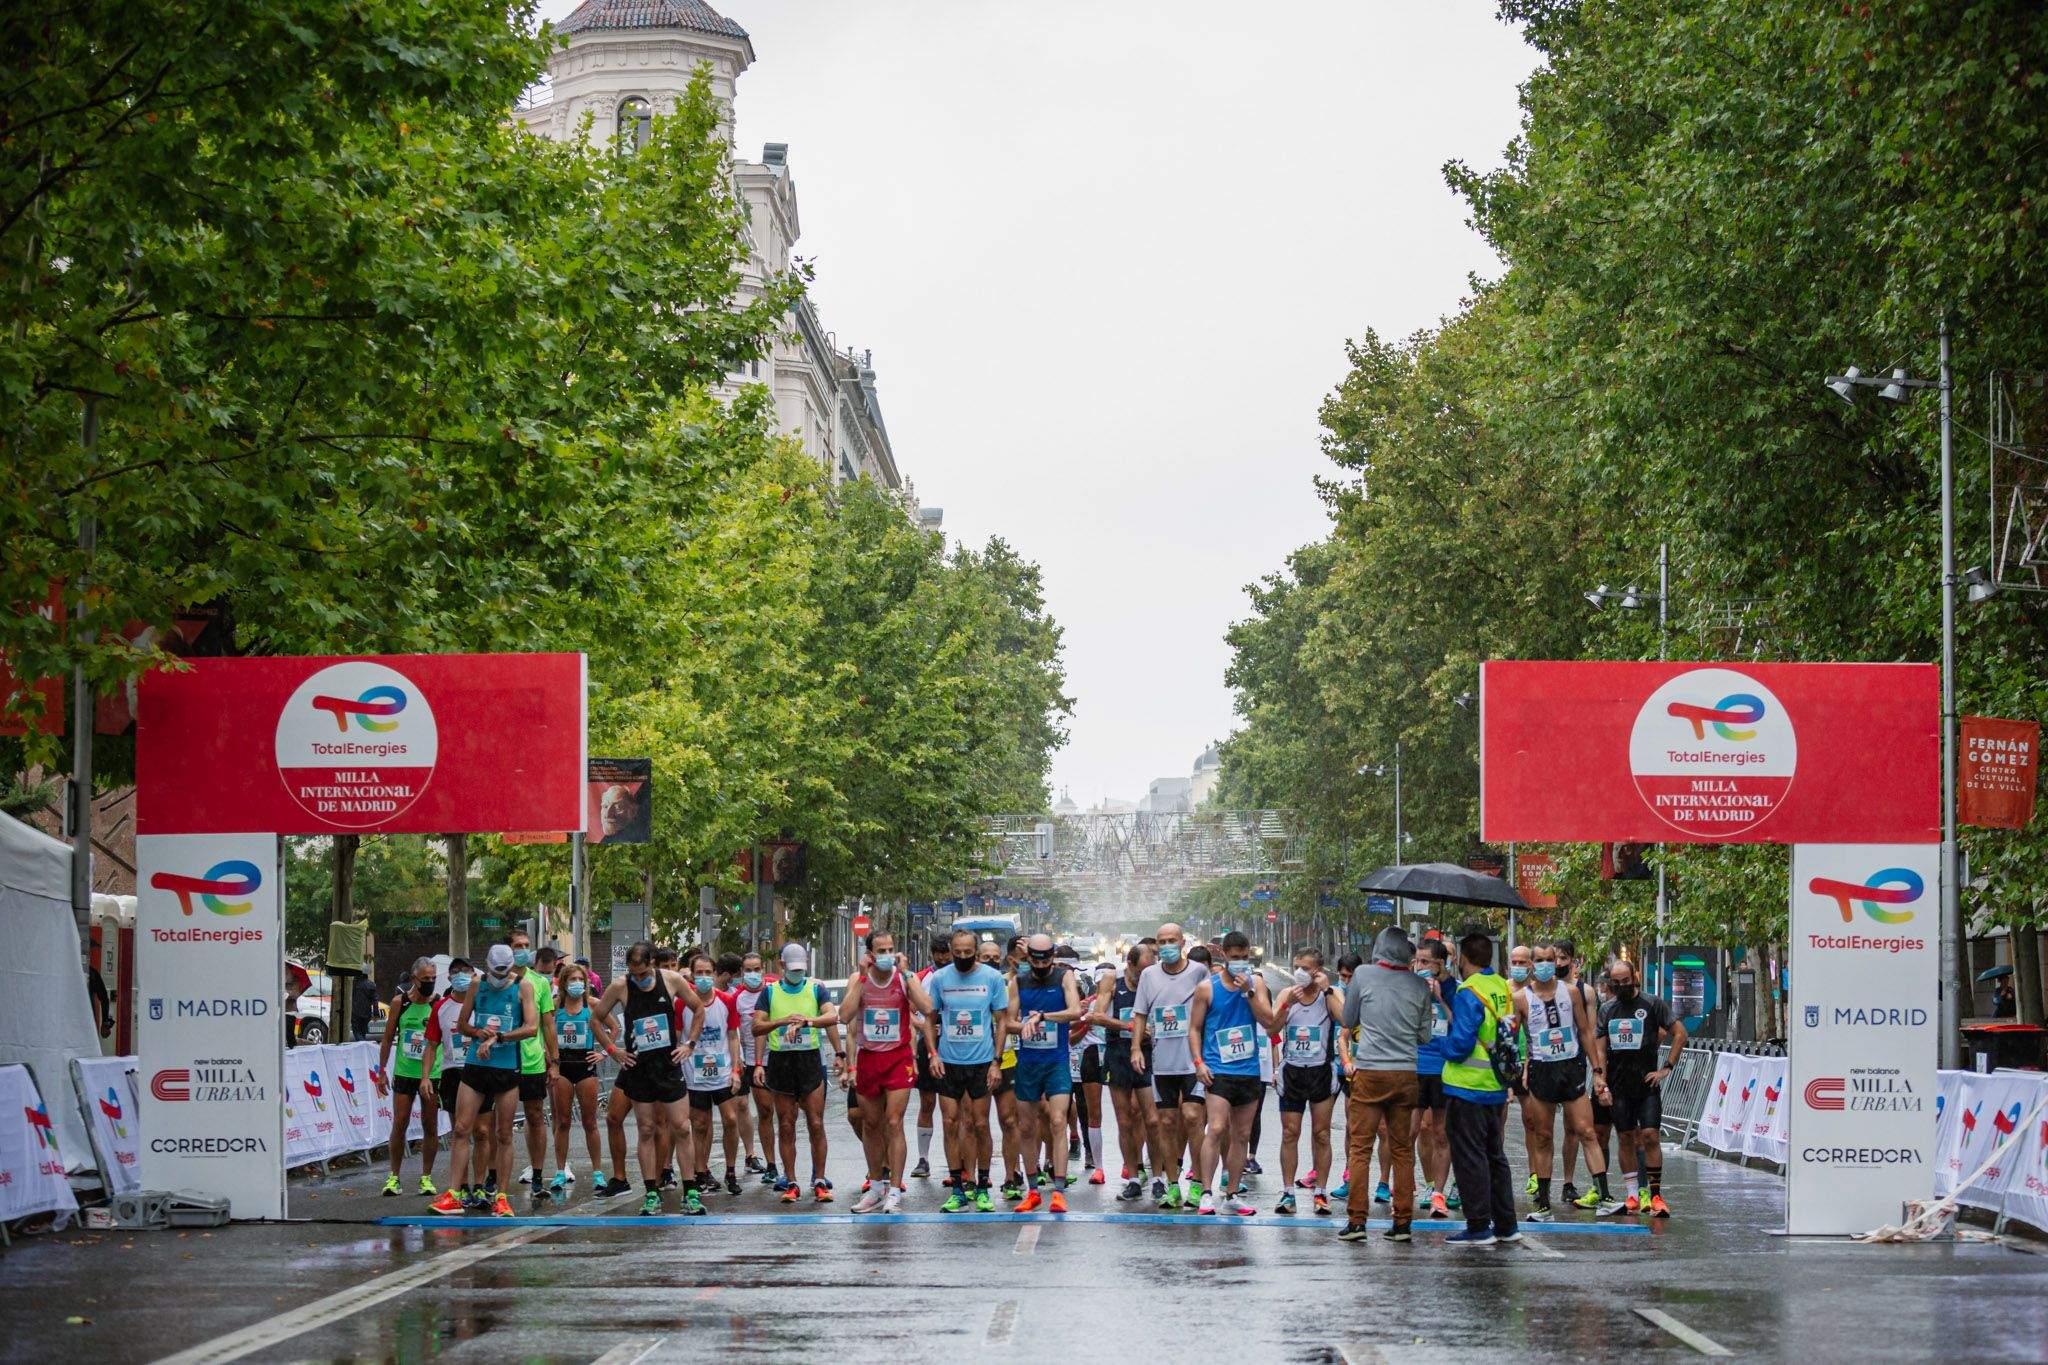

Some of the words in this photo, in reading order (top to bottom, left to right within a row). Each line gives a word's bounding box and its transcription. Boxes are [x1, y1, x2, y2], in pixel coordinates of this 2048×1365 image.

[312, 742, 407, 757] TotalEnergies
[1969, 737, 2029, 752] FERNÁN
[1667, 750, 1766, 766] TotalEnergies
[1968, 749, 2028, 766] GÓMEZ
[1979, 766, 2016, 774] CENTRO
[335, 772, 380, 783] MILLA
[1974, 774, 2021, 783] CULTURAL
[1691, 780, 1738, 792] MILLA
[1999, 784, 2027, 792] VILLA
[318, 801, 337, 812] DE
[340, 800, 397, 812] MADRID
[1674, 809, 1694, 821] DE
[1697, 809, 1755, 821] MADRID
[150, 926, 263, 945] TotalEnergies
[1808, 935, 1924, 953] TotalEnergies
[178, 999, 268, 1017] MADRID
[1835, 1008, 1927, 1026] MADRID
[875, 1025, 889, 1035] 217
[956, 1025, 974, 1036] 205
[1162, 1021, 1179, 1032] 222
[563, 1035, 577, 1044] 189
[645, 1032, 662, 1043] 135
[1618, 1033, 1634, 1043] 198
[410, 1044, 423, 1054] 176
[1231, 1043, 1246, 1054] 211
[1296, 1040, 1311, 1051] 212
[1550, 1044, 1566, 1055] 214
[211, 1058, 243, 1066] balance
[195, 1069, 256, 1083] MILLA
[702, 1067, 719, 1077] 208
[1867, 1067, 1900, 1075] balance
[1851, 1078, 1912, 1093] MILLA
[195, 1086, 266, 1101] URBANA
[1850, 1096, 1923, 1112] URBANA
